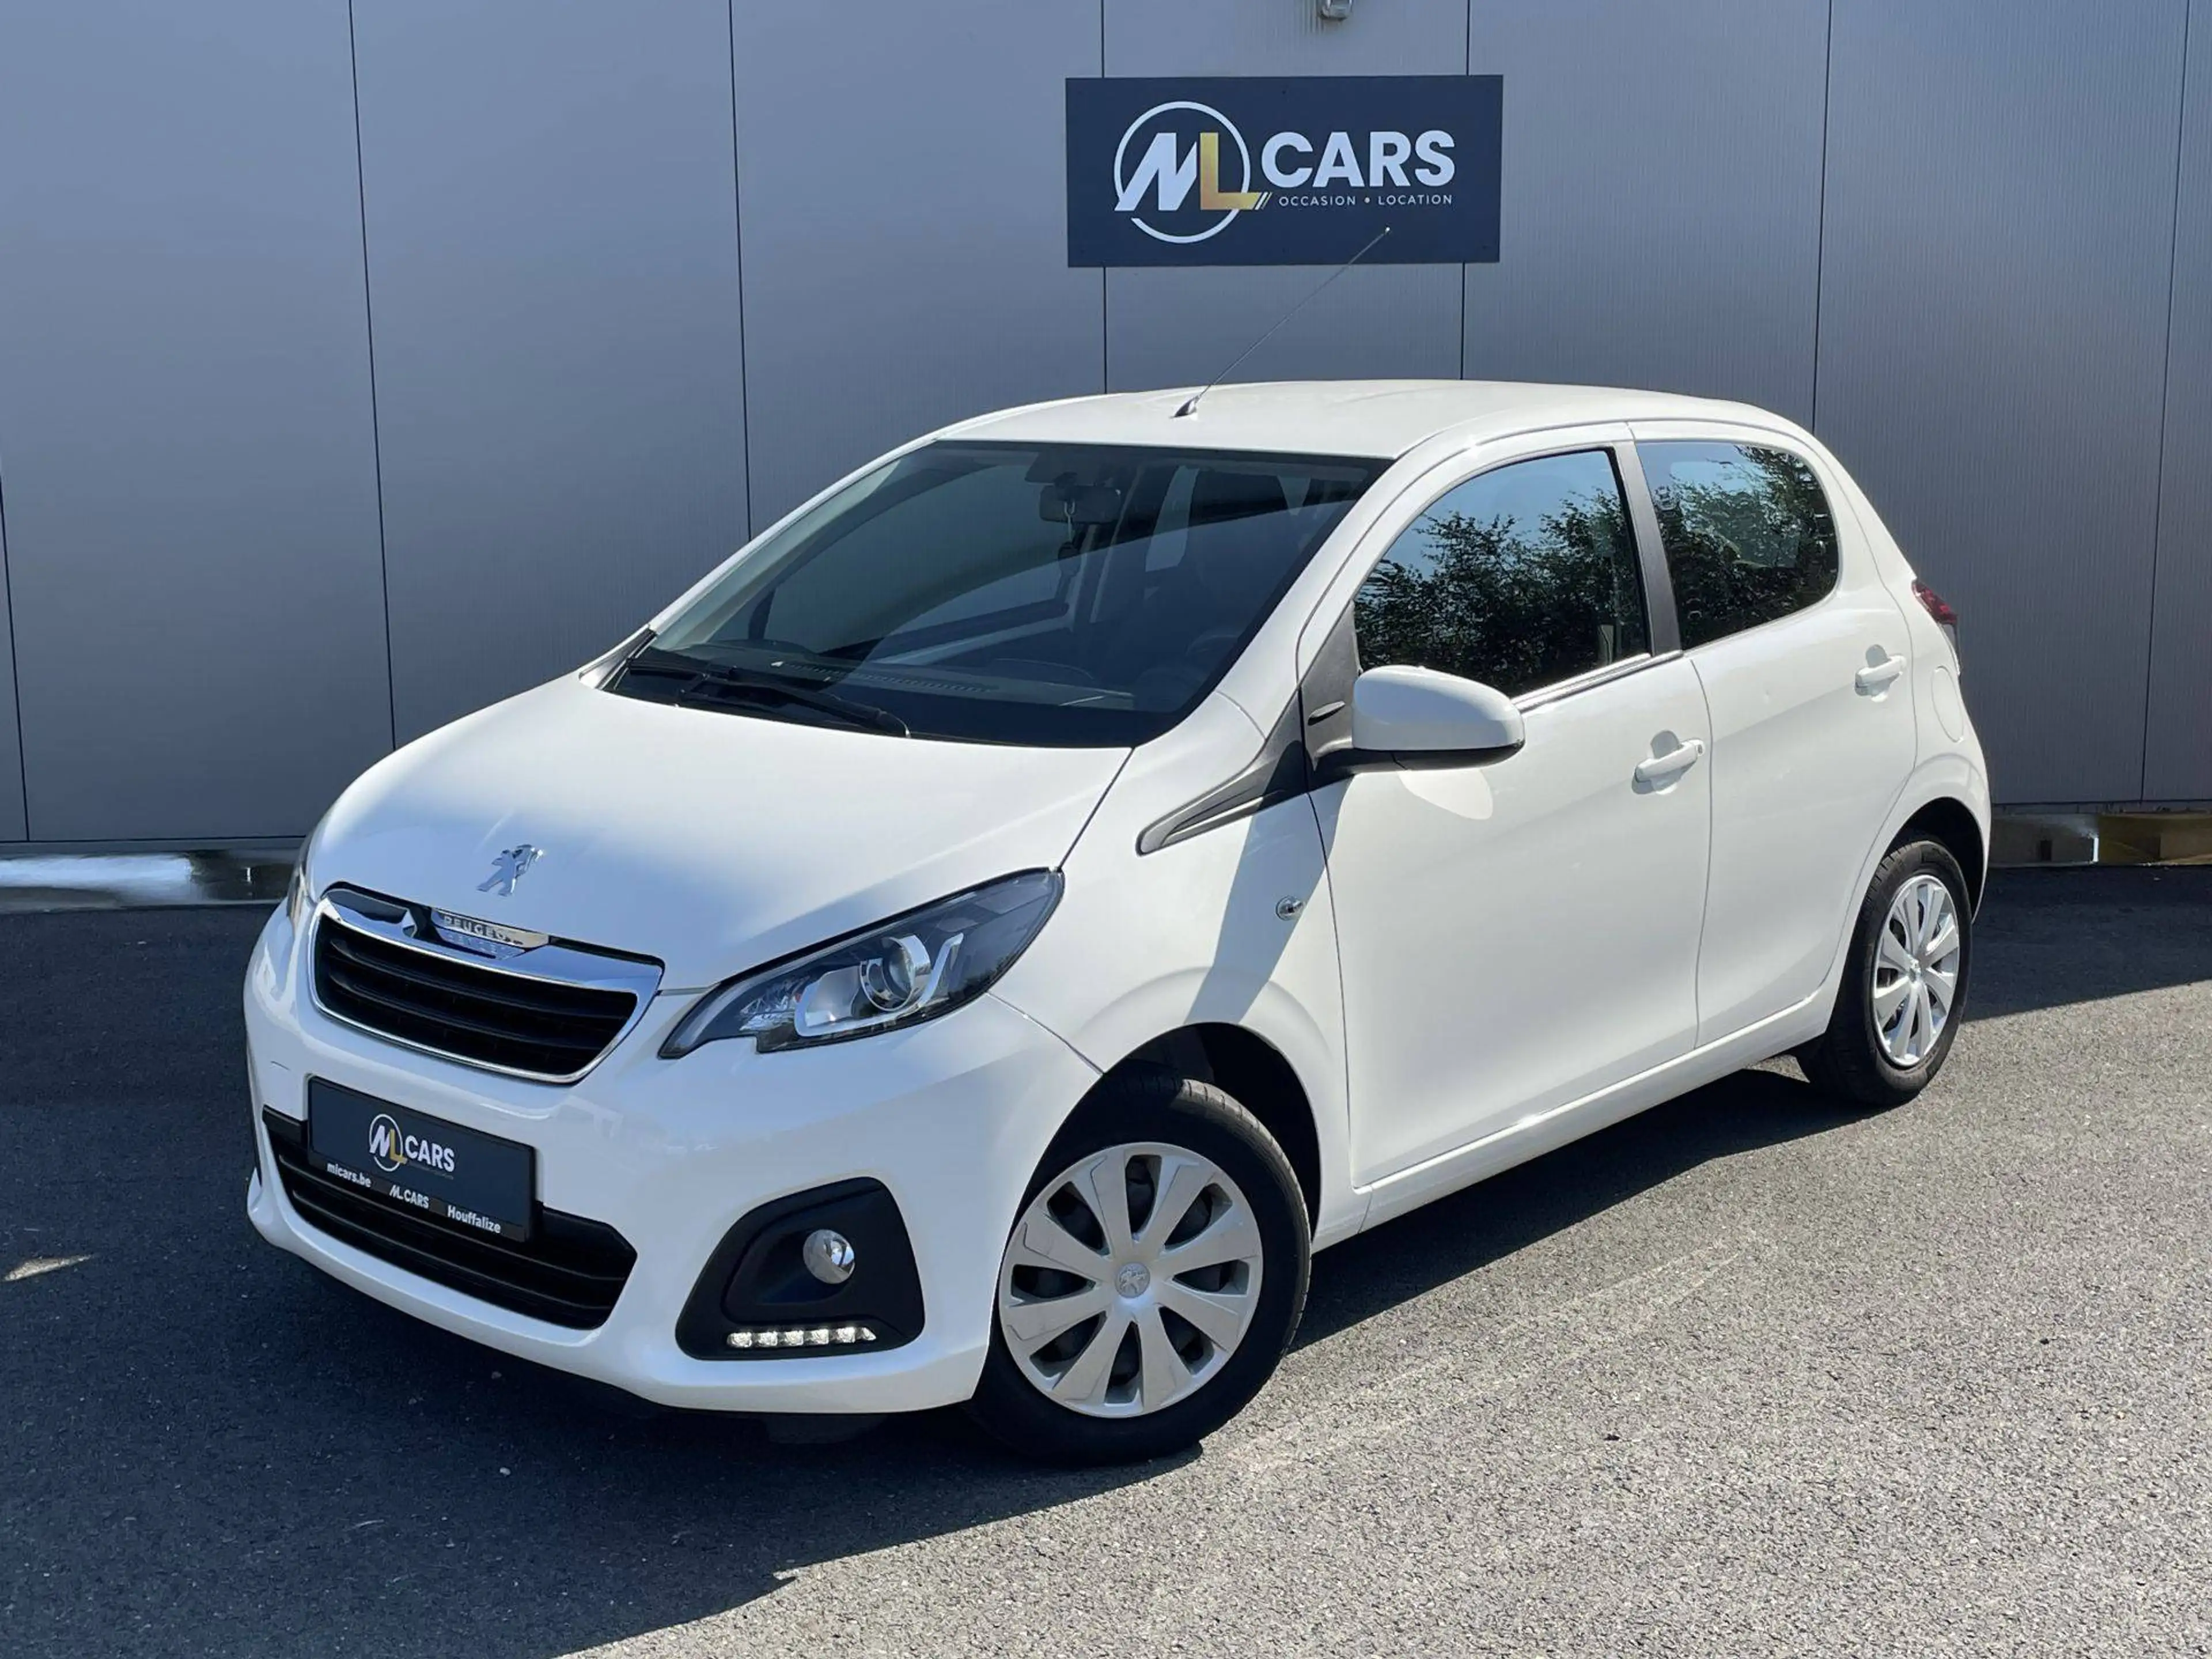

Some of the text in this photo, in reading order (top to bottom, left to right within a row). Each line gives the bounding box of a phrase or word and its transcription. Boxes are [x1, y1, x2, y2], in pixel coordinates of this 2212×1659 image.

[1114, 130, 1456, 211] ML CARS
[1278, 194, 1453, 206] OCCASION LOCATION
[369, 1125, 408, 1164] ML
[405, 1135, 455, 1172] CARS
[404, 1189, 430, 1209] CARS
[448, 1205, 501, 1233] Houffalize
